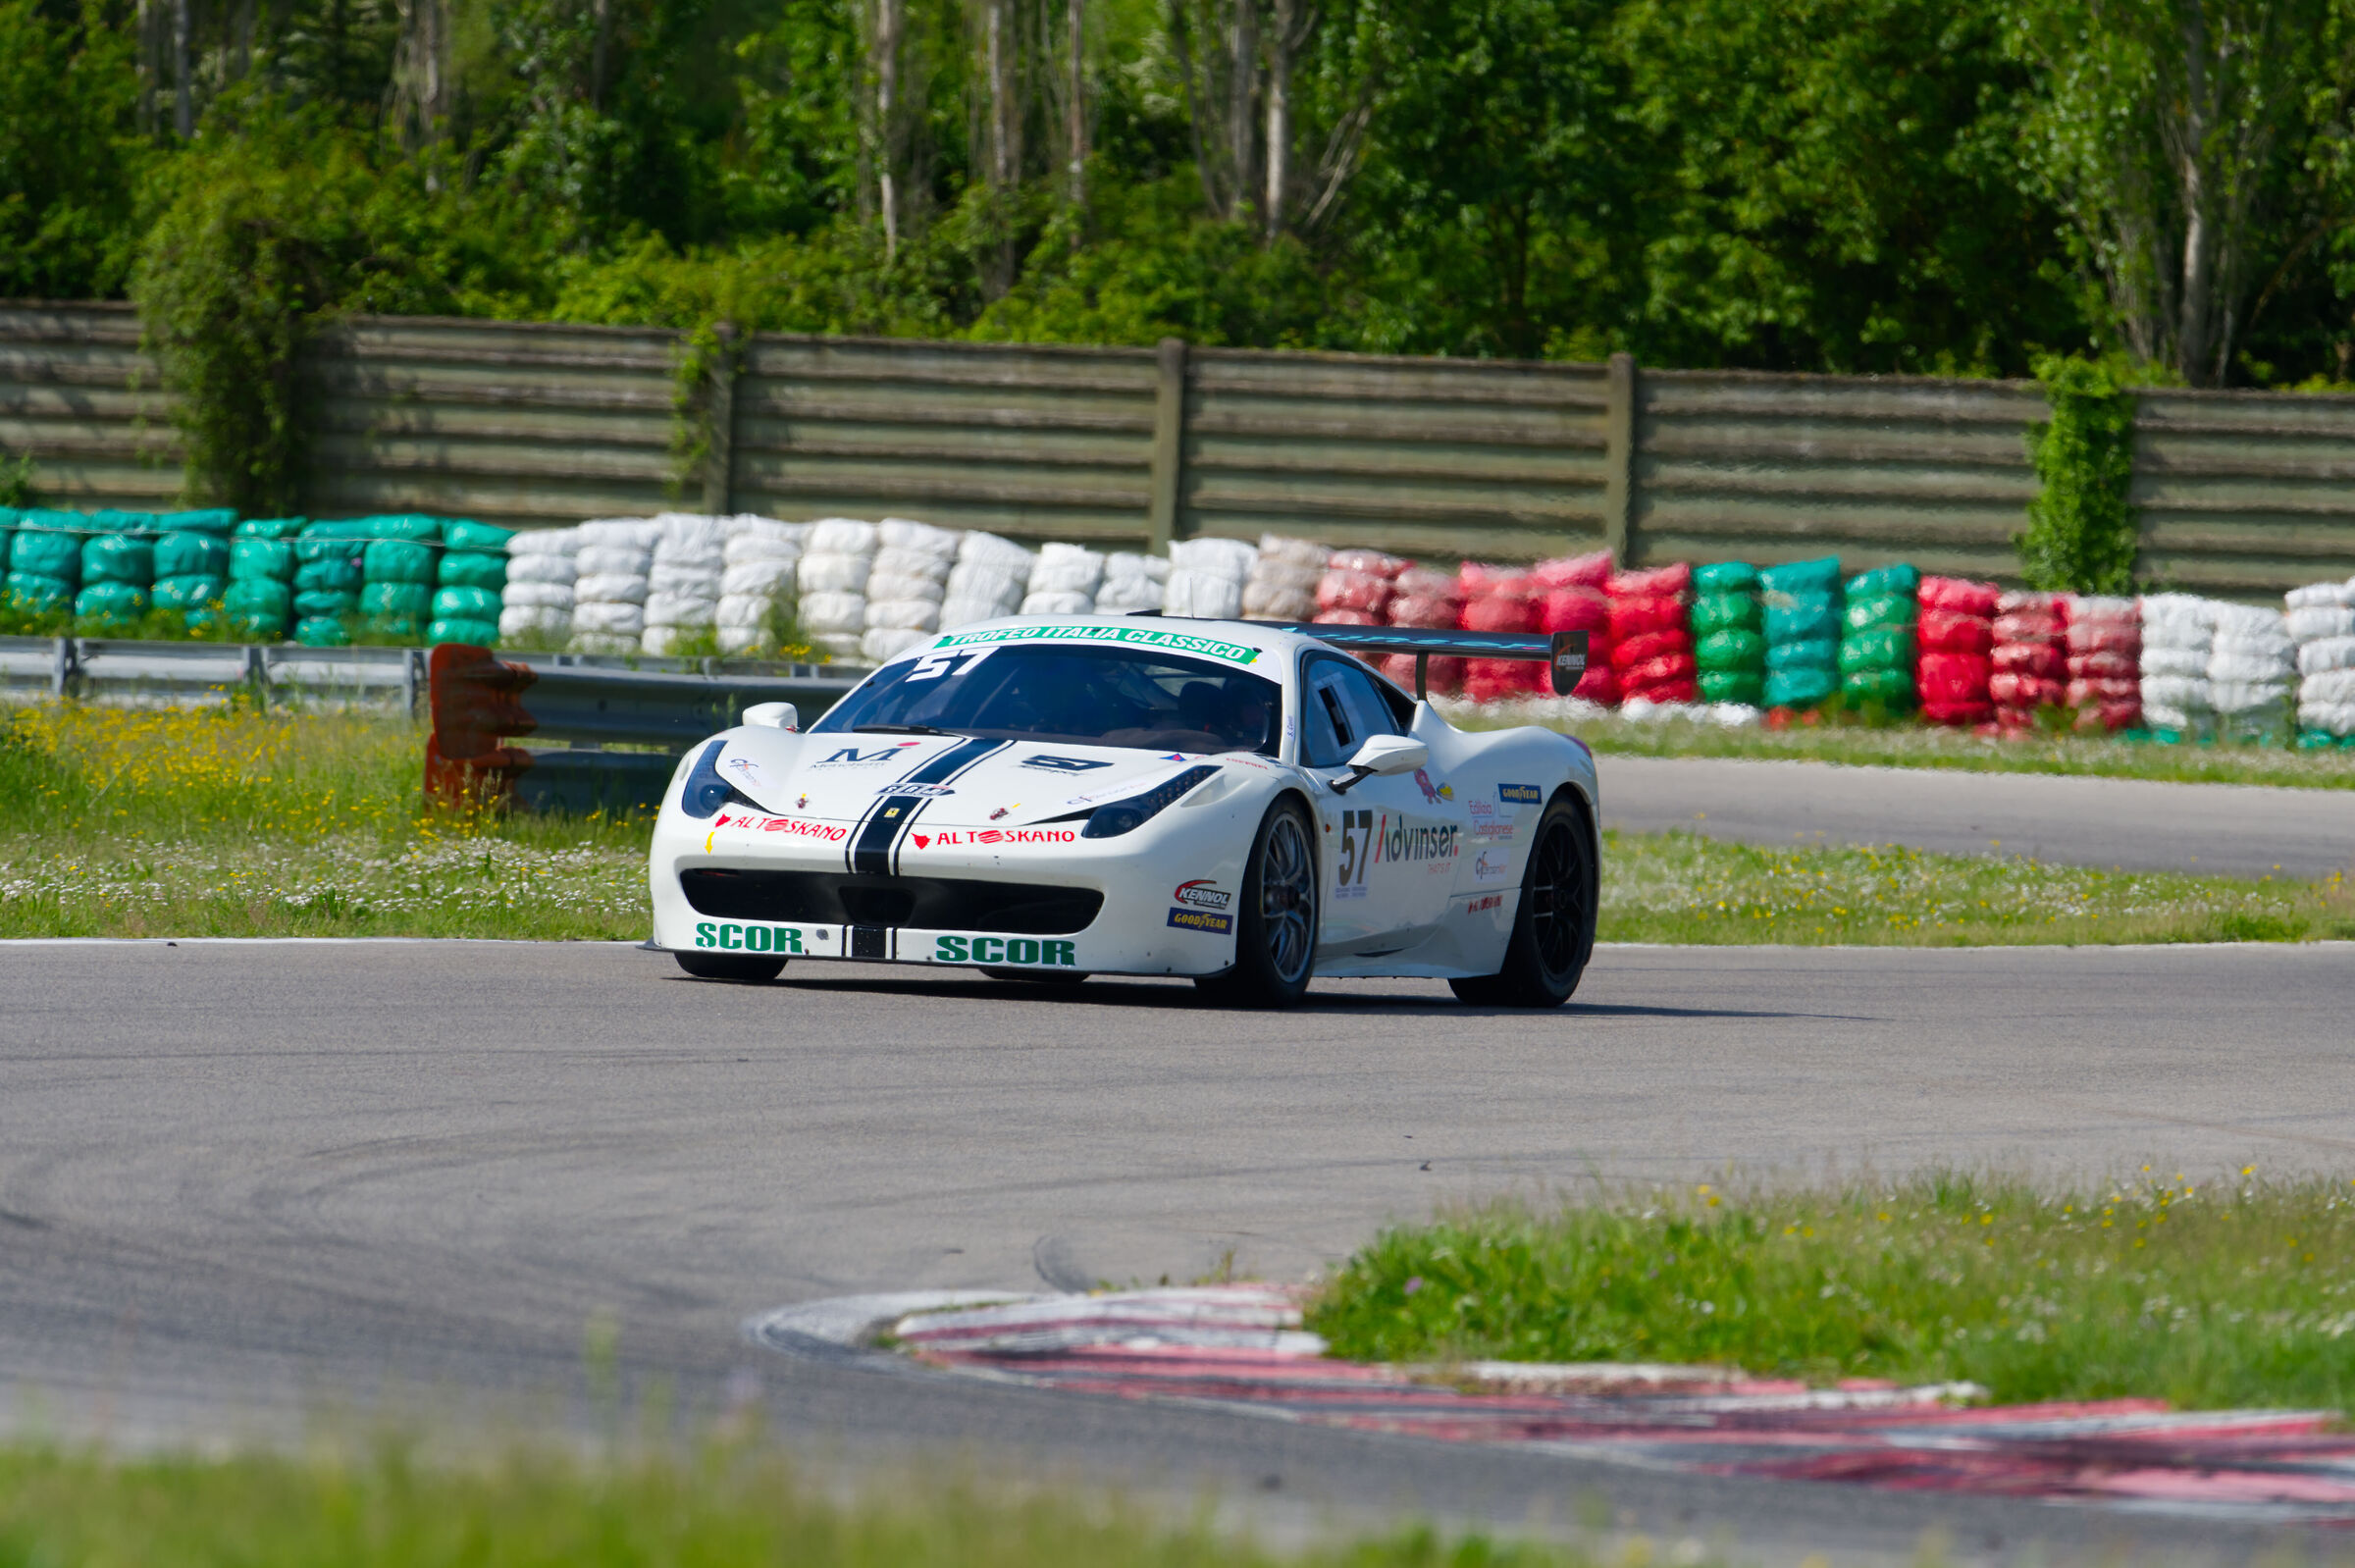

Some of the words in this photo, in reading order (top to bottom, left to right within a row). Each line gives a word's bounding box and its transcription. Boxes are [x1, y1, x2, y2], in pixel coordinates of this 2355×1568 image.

[950, 626, 1042, 646] TROFEO
[1046, 626, 1122, 640] ITALIA
[1125, 630, 1247, 660] CLASSICO
[905, 646, 1002, 684] 57
[1502, 785, 1539, 801] GOODYEAR
[1338, 809, 1373, 887] 57
[1178, 886, 1230, 905] KENNOL
[1174, 913, 1229, 930] GOODYEAR
[695, 922, 804, 954] SCOR
[935, 935, 1076, 967] SCOR
